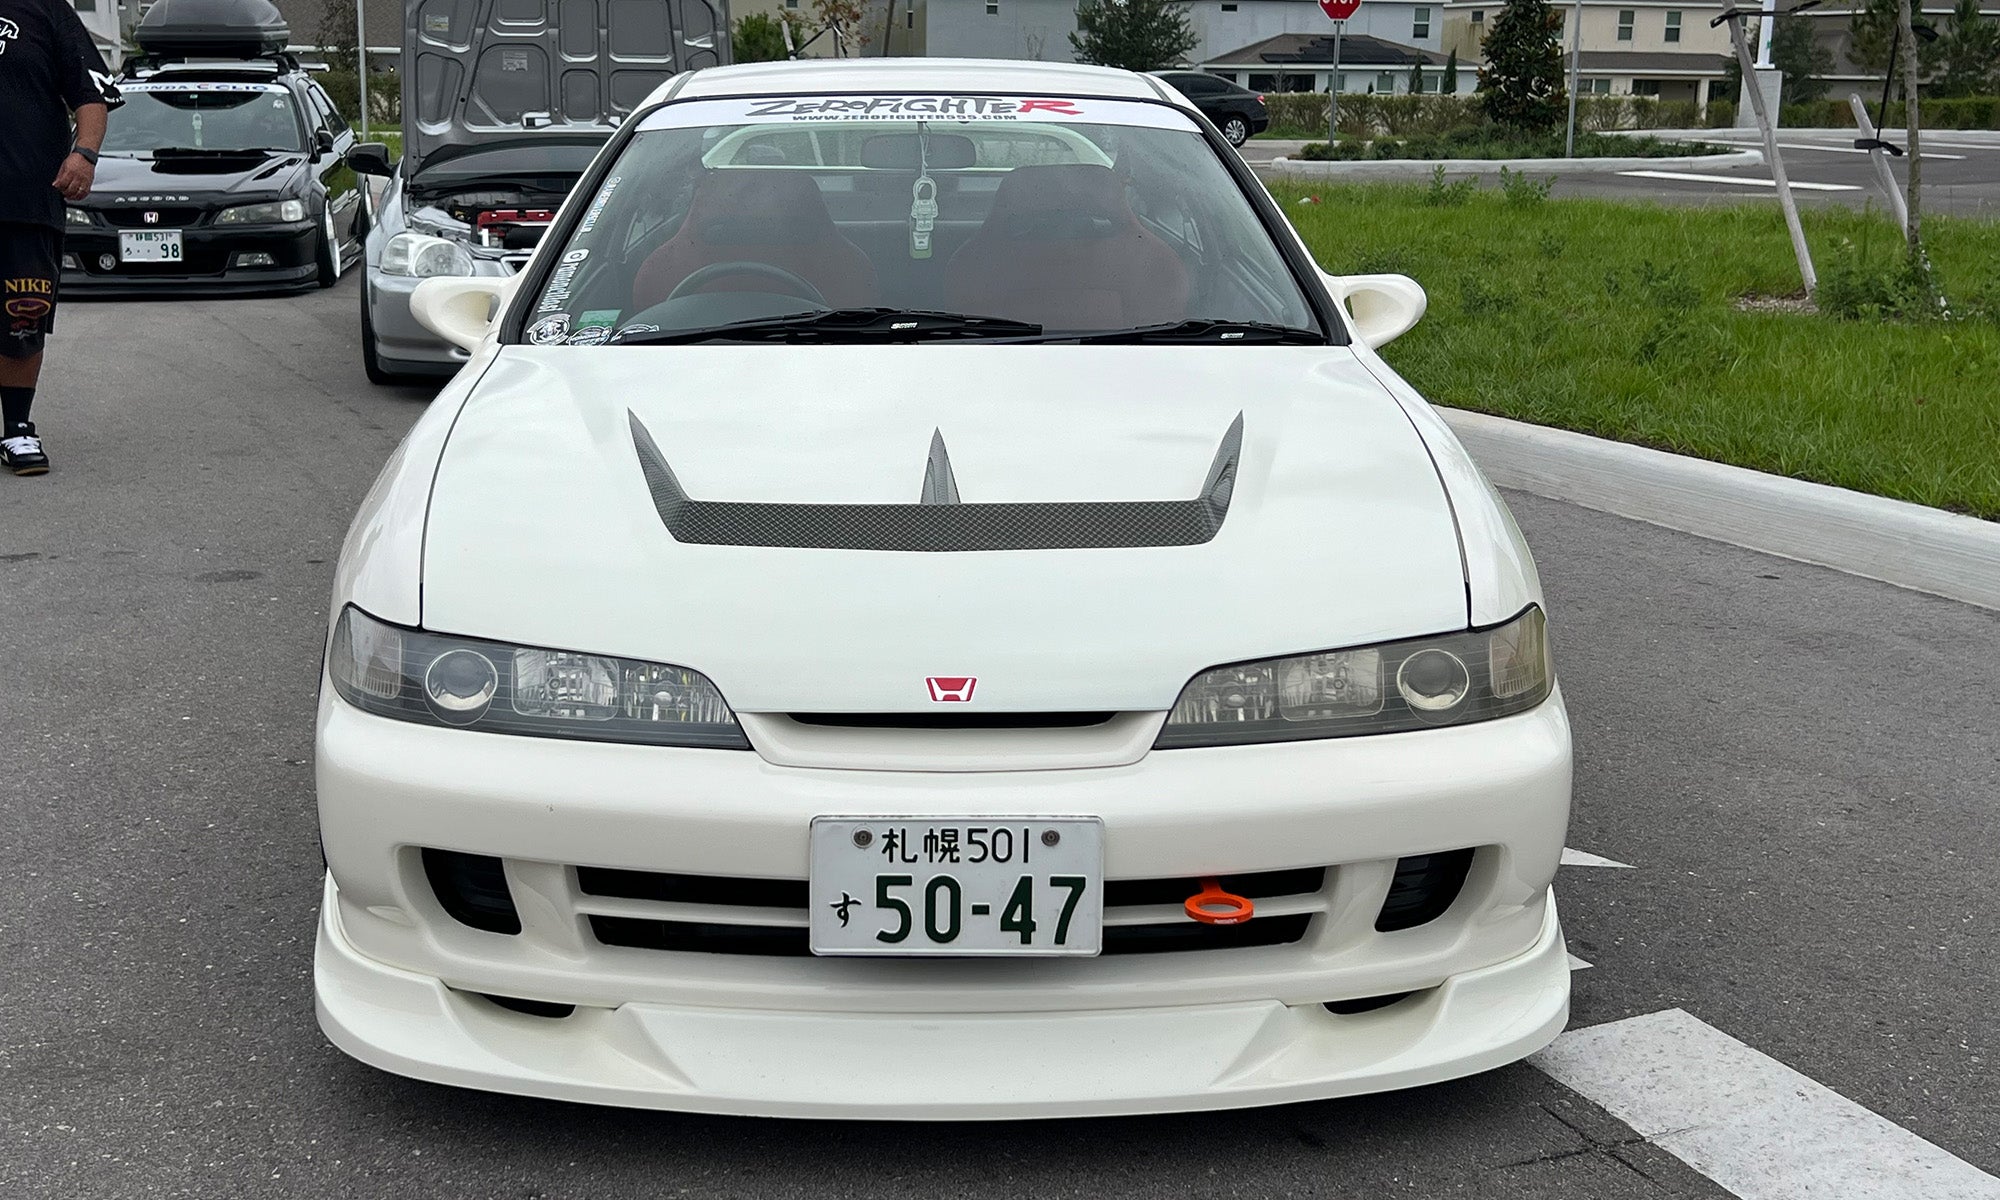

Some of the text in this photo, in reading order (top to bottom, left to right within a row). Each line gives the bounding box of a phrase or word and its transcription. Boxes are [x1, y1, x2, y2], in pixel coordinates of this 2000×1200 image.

[160, 243, 180, 259] 98
[5, 278, 52, 294] NIKE
[880, 827, 1031, 864] 札幌501
[829, 874, 1087, 945] す 50-47
